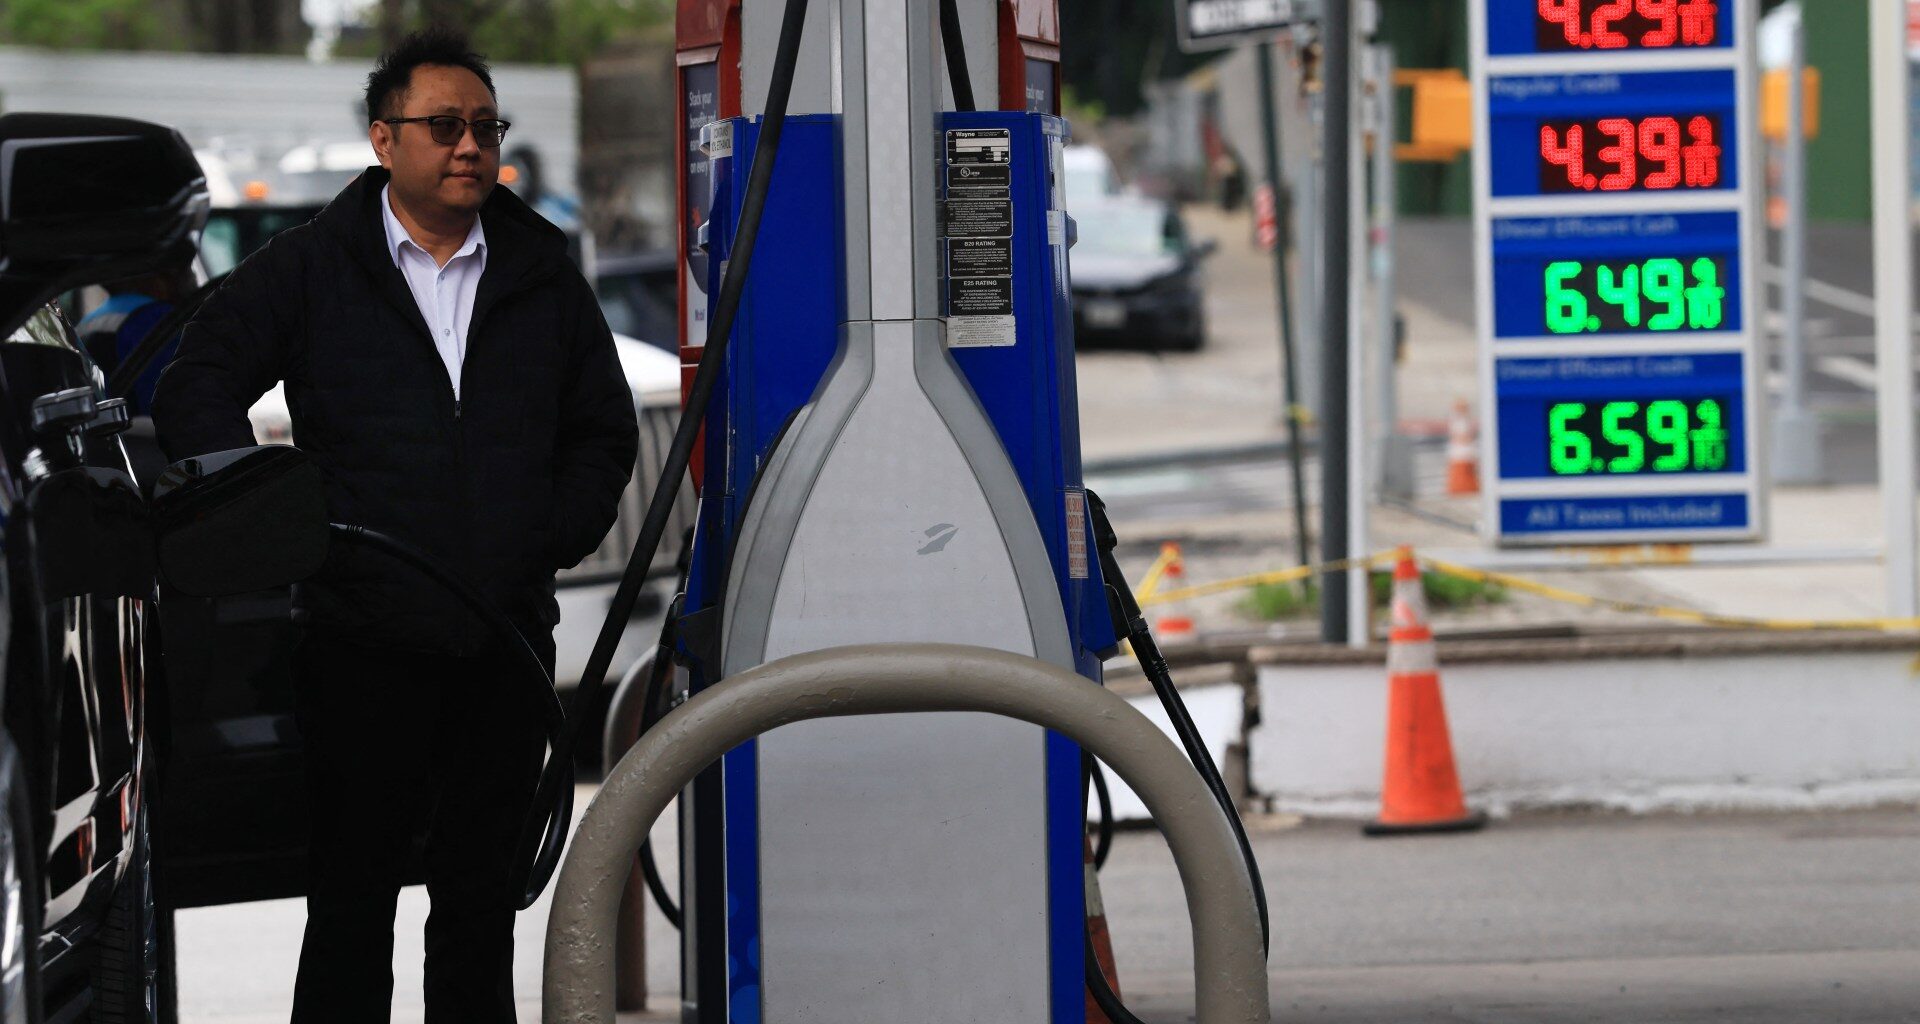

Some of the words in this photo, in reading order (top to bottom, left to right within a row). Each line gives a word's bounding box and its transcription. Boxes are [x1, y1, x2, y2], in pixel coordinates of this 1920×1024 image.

[1538, 0, 1678, 48] 4.29
[1564, 76, 1621, 94] Credit
[956, 131, 976, 139] Wayne
[1541, 117, 1681, 191] 4.39
[1545, 258, 1686, 333] 6.49
[1549, 400, 1690, 475] 6.59
[1527, 504, 1558, 526] All
[1627, 499, 1722, 523] Included
